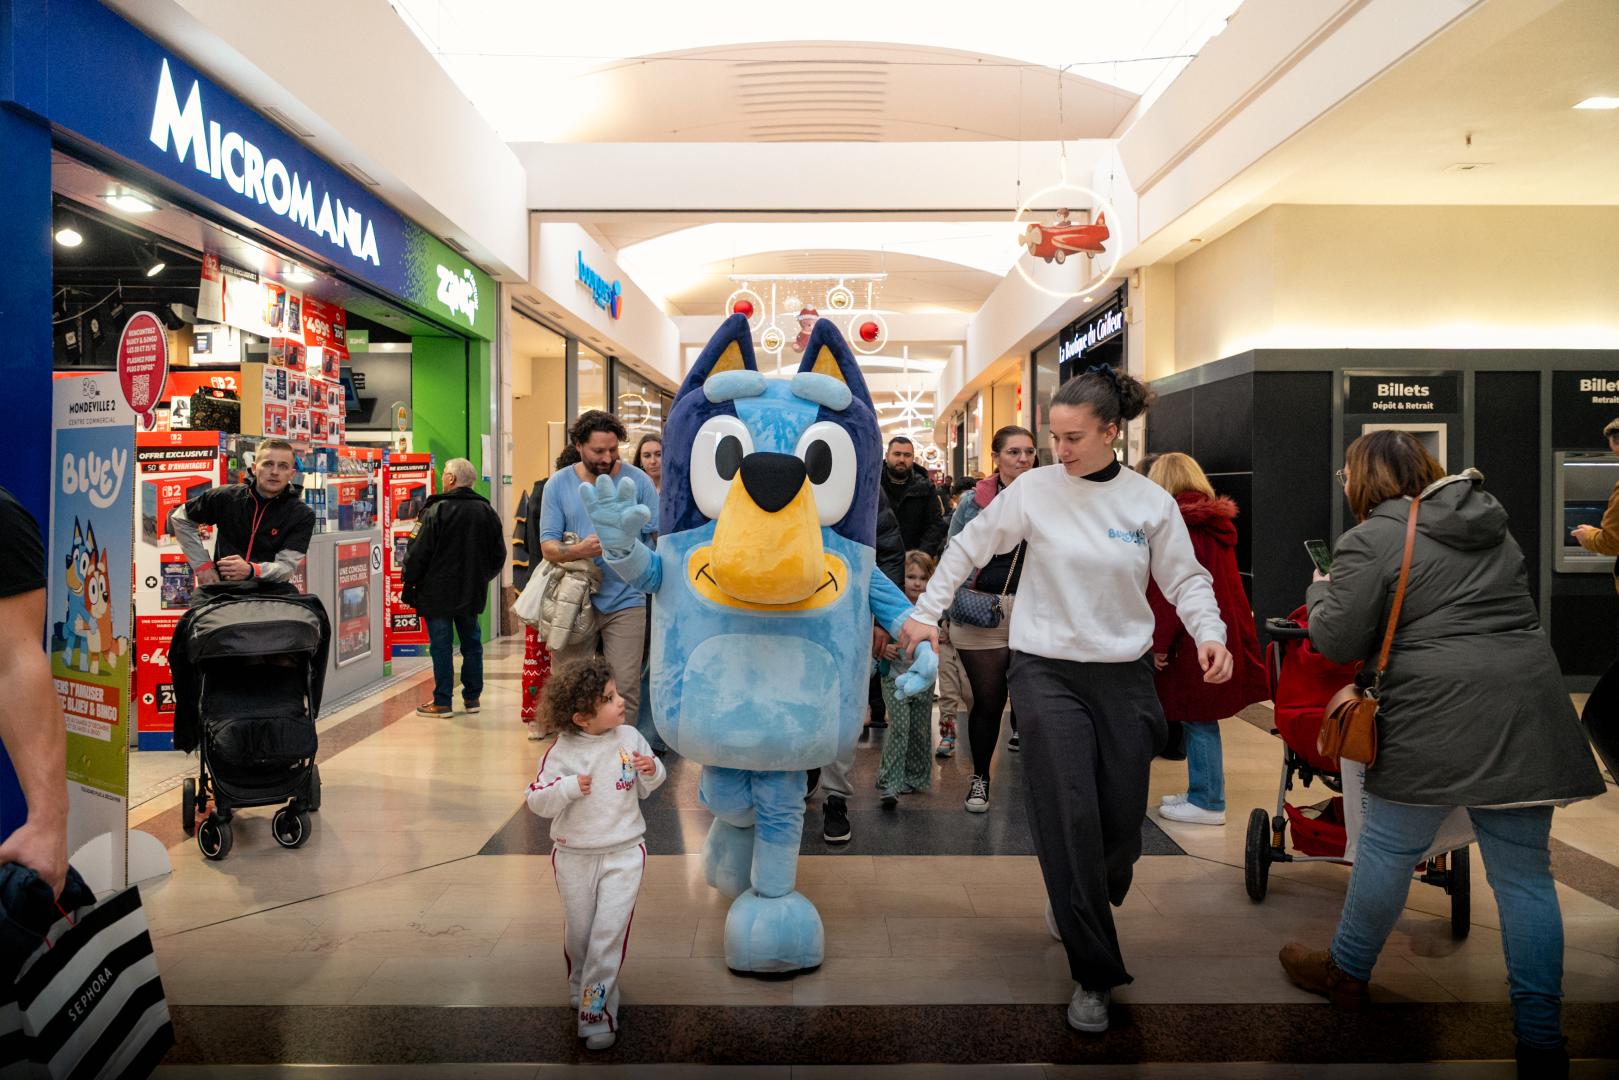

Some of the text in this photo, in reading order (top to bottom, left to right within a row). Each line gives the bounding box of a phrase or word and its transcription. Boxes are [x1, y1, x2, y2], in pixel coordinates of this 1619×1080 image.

[149, 57, 381, 266] MICROMANIA
[1065, 333, 1088, 360] Boutique
[1088, 323, 1096, 347] du
[1096, 310, 1122, 341] Coiffeur
[1377, 382, 1430, 397] Billets
[69, 399, 116, 414] MONDEVILLE 2
[1397, 401, 1405, 410] &
[1405, 401, 1434, 410] Retrait
[139, 452, 165, 460] OFFRE
[166, 450, 209, 459] EXCLUSIVE
[62, 447, 127, 509] BLUEY
[173, 484, 182, 497] 2
[395, 618, 417, 627] 20€
[69, 682, 104, 703] T'AMUSER
[67, 696, 89, 715] BLUEY
[89, 701, 95, 716] &
[96, 703, 118, 721] BINGO
[68, 967, 113, 1022] SEPHORA
